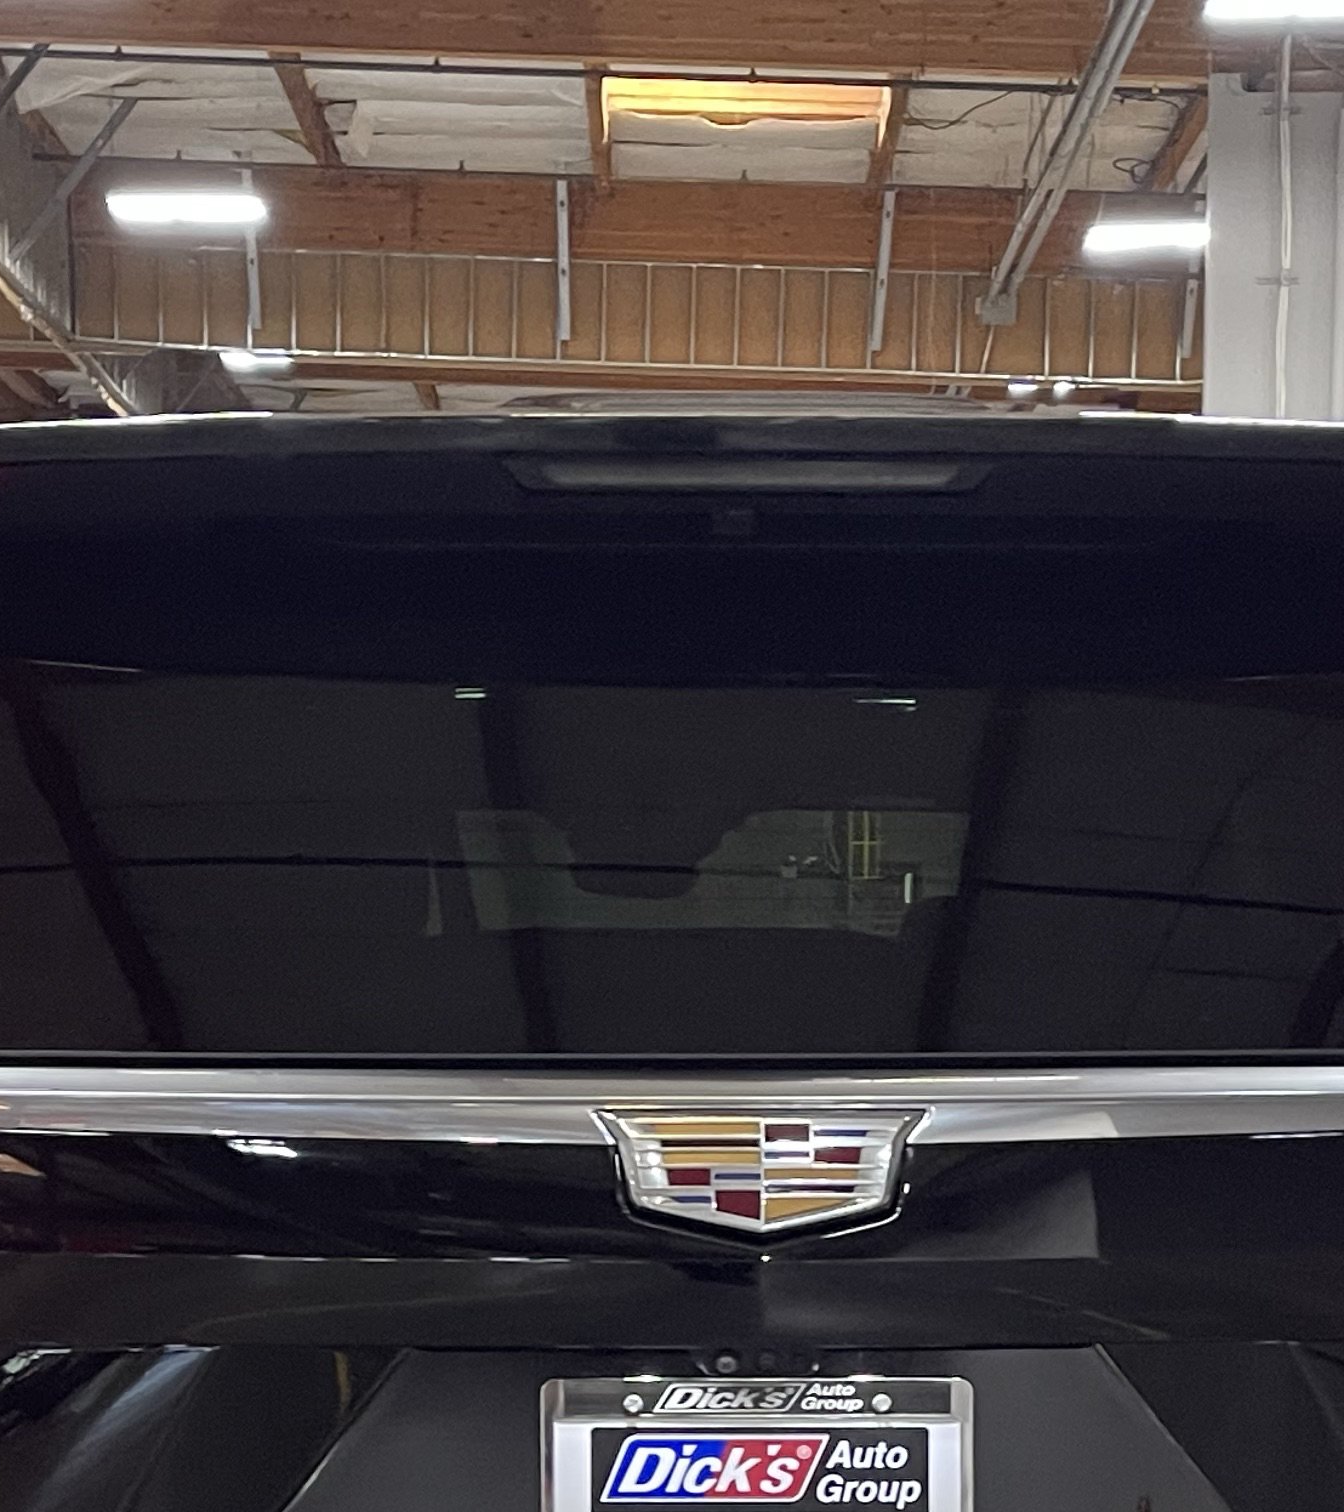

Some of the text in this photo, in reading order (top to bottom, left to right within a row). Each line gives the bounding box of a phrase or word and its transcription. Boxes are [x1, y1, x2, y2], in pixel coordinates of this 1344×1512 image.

[665, 1386, 788, 1410] Dick's
[806, 1383, 856, 1397] Auto
[801, 1396, 865, 1412] Group
[825, 1439, 908, 1470] Auto
[617, 1444, 801, 1494] Dick's
[815, 1473, 922, 1510] Group
